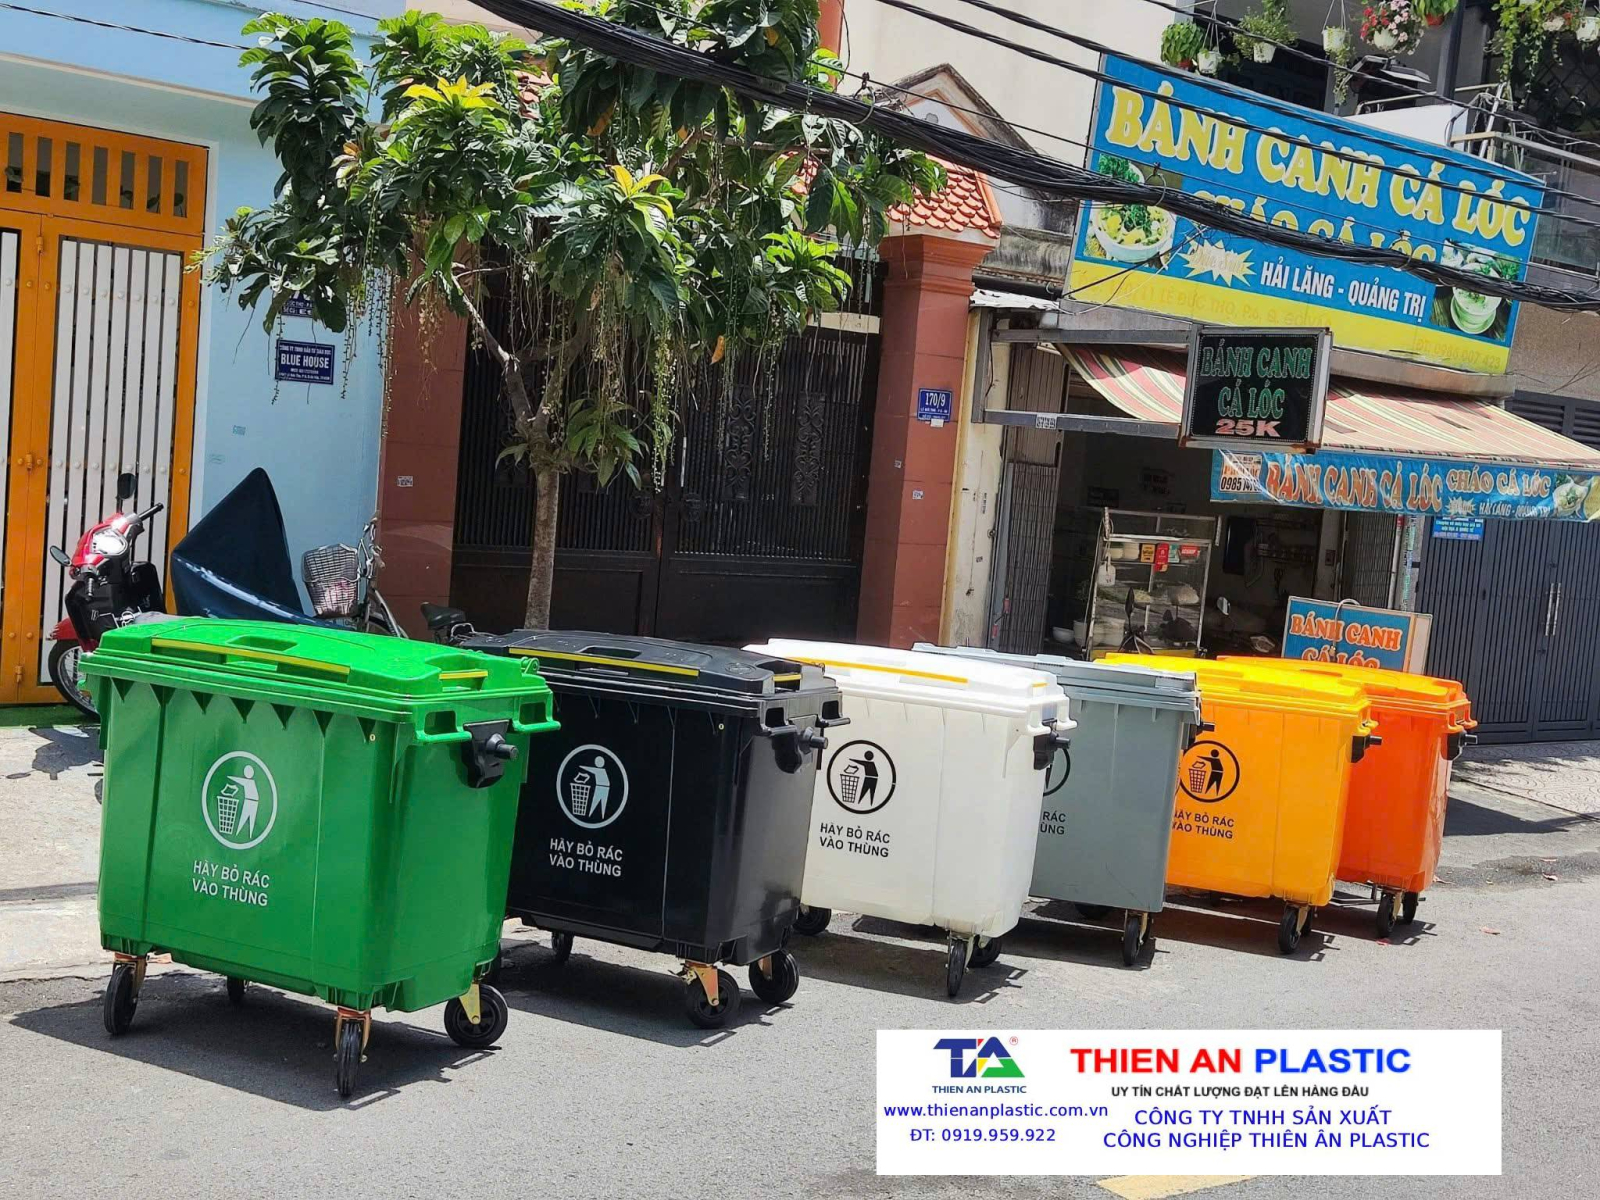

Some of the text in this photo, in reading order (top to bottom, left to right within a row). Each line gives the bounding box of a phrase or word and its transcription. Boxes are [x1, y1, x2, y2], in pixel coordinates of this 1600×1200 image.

[1106, 81, 1530, 246] BÁNH CANH CÁ LÓC
[1261, 257, 1291, 289] HẢI
[1292, 264, 1335, 299] LĂNG
[1348, 277, 1399, 315] QUẢNG
[1403, 291, 1427, 322] TRỊ
[281, 353, 330, 369] BLUE HOUSE
[1200, 338, 1312, 379] BÁNH CANH
[925, 393, 946, 408] 170/9
[1218, 378, 1285, 419] CÁ LÓC
[1215, 419, 1281, 437] 25K
[1220, 477, 1242, 491] 0985
[1323, 465, 1378, 507] CANH
[1379, 461, 1403, 510] CÁ
[1407, 463, 1443, 512] LÓC
[1446, 465, 1550, 498] CHÁO CÁ LÓC
[1290, 611, 1402, 651] BÁNH CANH
[1043, 810, 1066, 823] RÁC
[1194, 811, 1209, 823] BỎ
[1212, 816, 1234, 828] RÁC
[847, 825, 862, 839] BỎ
[866, 830, 890, 844] RÁC
[1196, 825, 1233, 839] THÙNG
[576, 840, 594, 857] BỎ
[597, 845, 623, 861] RÁC
[820, 836, 889, 858] VÀO THÙNG
[221, 863, 239, 882] BỎ
[242, 870, 270, 888] RÁC
[549, 853, 621, 877] VÀO THÙNG
[192, 877, 268, 906] VÀO THÙNG
